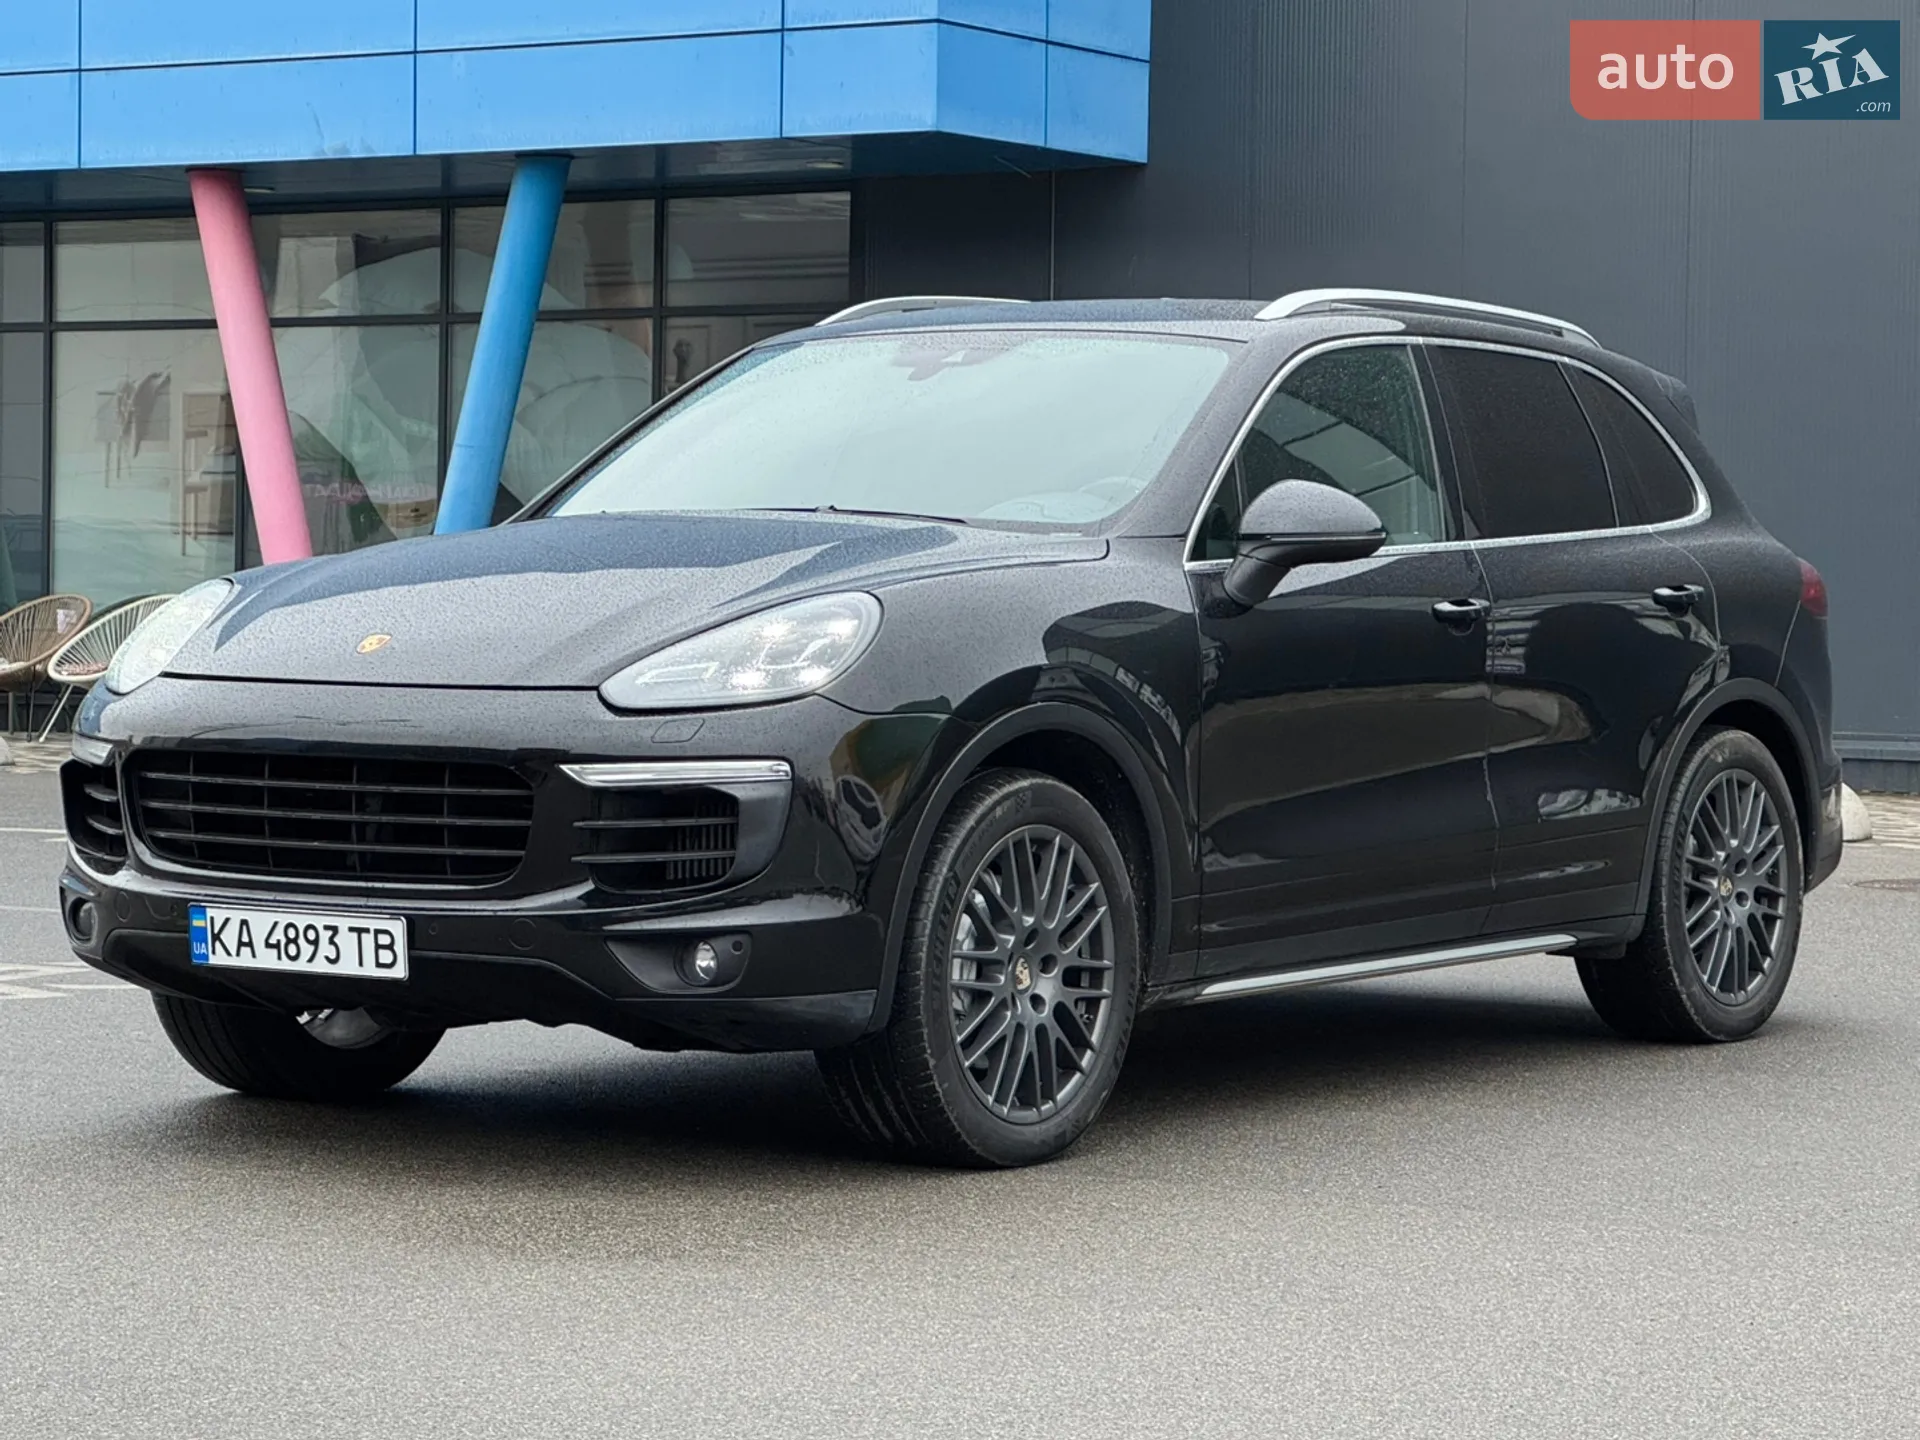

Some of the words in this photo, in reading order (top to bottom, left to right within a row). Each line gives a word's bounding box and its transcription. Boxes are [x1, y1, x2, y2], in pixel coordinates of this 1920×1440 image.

[193, 942, 208, 956] UA
[209, 915, 257, 959] KA
[264, 920, 341, 965] 4893
[347, 926, 398, 969] TB
